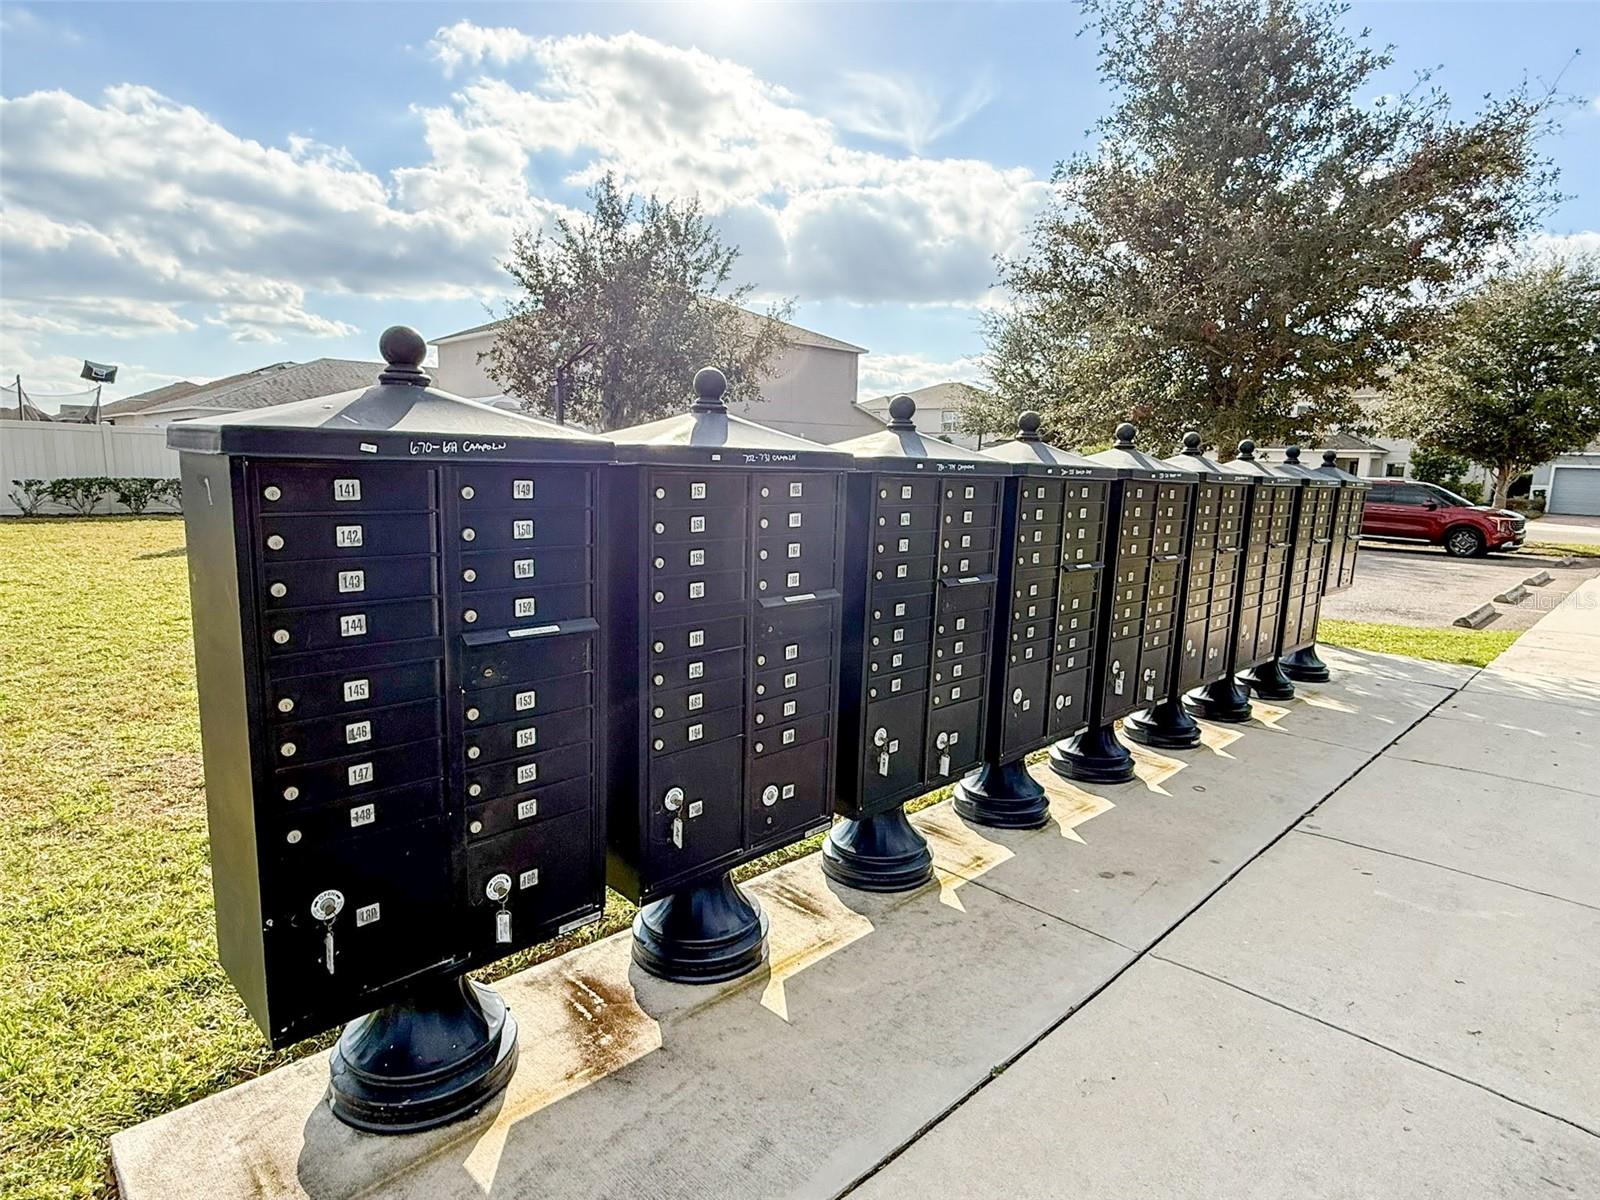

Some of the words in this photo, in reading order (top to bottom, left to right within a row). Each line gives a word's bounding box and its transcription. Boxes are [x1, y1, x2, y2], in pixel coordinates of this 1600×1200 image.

[338, 484, 356, 497] 141
[516, 484, 530, 496] 149
[339, 530, 359, 544] 142
[516, 524, 531, 537] 150
[341, 575, 360, 588] 143
[518, 602, 532, 613] 152
[343, 619, 363, 634] 144
[347, 684, 365, 697] 145
[518, 695, 532, 707] 153
[348, 726, 367, 741] 146
[519, 732, 533, 744] 154
[353, 767, 369, 782] 147
[520, 767, 534, 780] 155
[353, 808, 372, 822] 148
